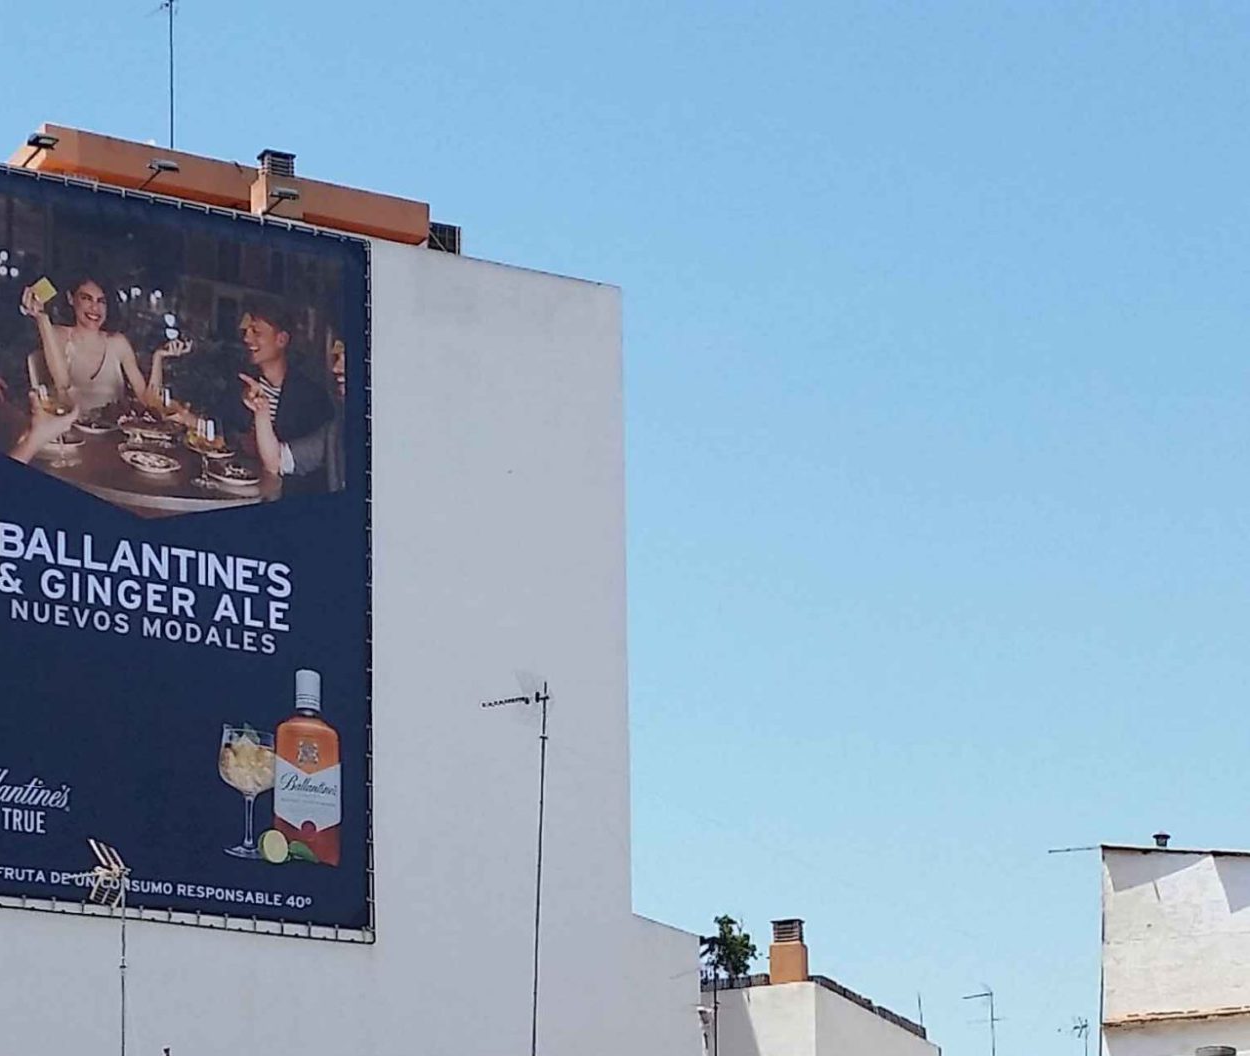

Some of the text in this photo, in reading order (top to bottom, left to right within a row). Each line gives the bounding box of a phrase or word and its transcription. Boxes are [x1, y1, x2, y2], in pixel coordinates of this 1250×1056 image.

[40, 568, 196, 619] GINGER
[213, 594, 291, 632] ALE
[10, 598, 277, 655] NUEVOS MODALES
[2, 807, 47, 834] TRUE
[50, 871, 71, 885] DE
[176, 883, 283, 907] RESPONSABLE
